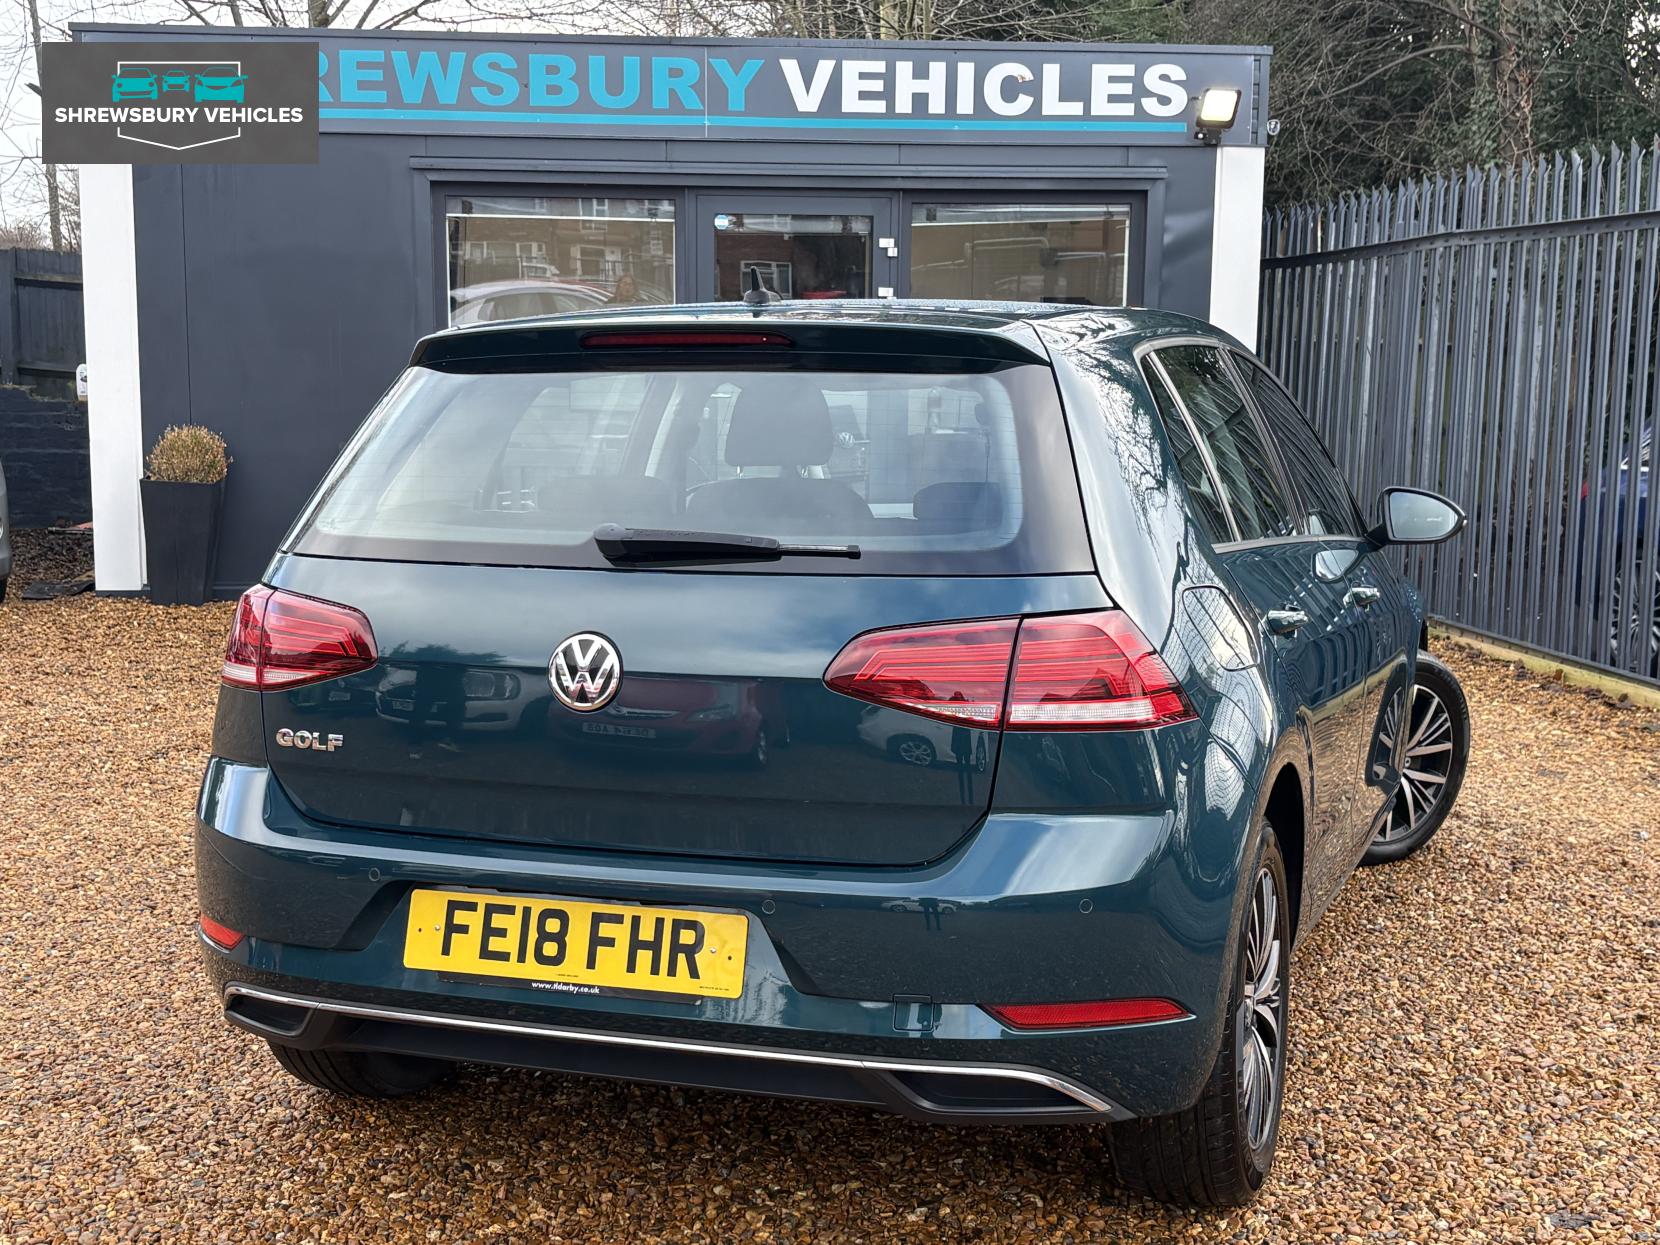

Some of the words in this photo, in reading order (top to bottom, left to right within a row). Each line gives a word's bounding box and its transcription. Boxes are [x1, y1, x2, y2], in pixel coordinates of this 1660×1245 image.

[319, 49, 765, 111] EWSBURY
[779, 59, 1188, 117] VEHICLES
[549, 633, 620, 711] VW
[276, 728, 344, 751] GOLF
[441, 900, 570, 966] FE18
[586, 912, 705, 979] FHR
